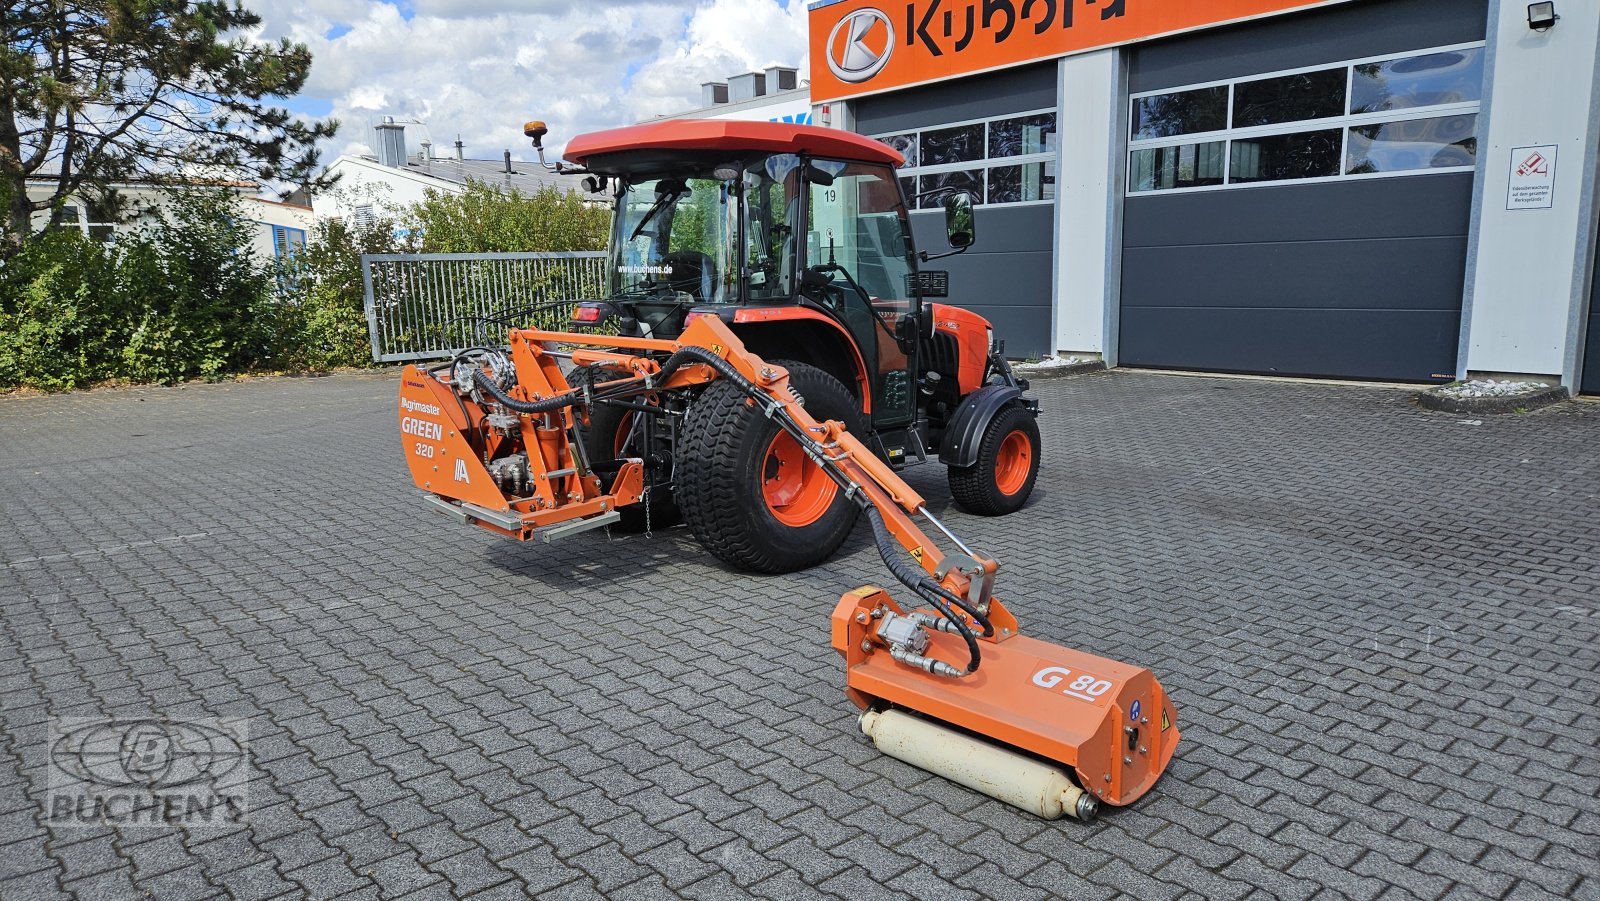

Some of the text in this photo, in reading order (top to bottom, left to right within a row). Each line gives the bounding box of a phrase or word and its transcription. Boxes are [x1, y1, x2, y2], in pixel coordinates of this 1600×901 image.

[824, 189, 836, 203] 19
[617, 264, 673, 274] www.buchens.de
[401, 416, 443, 441] GREEN
[415, 442, 434, 458] 320
[1032, 666, 1112, 696] G 80
